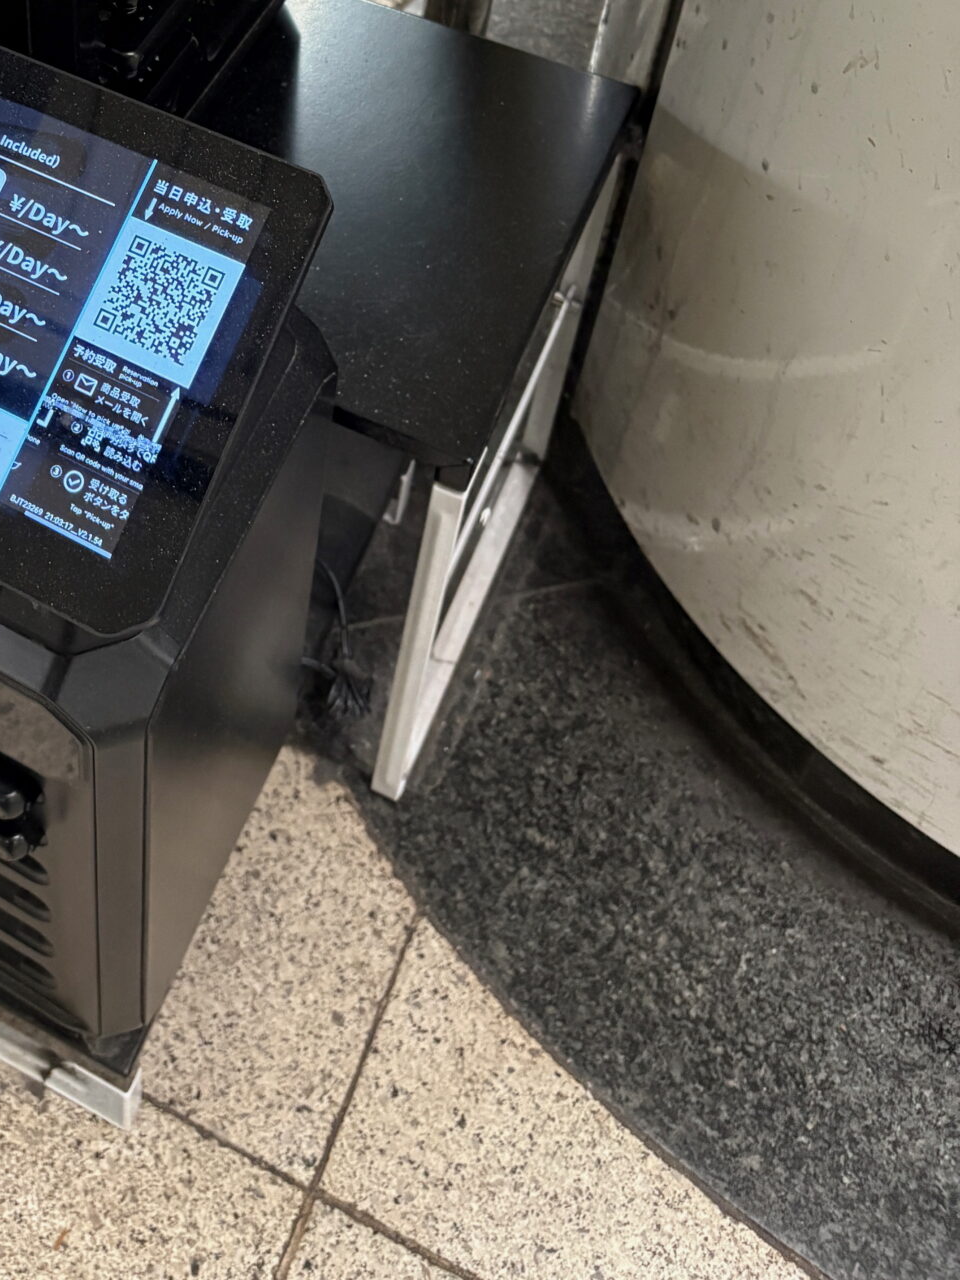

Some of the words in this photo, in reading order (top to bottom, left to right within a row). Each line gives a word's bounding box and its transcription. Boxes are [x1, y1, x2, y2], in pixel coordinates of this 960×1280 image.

[0, 134, 61, 169] Included)
[152, 178, 253, 231] 当日申込・受取
[157, 202, 184, 219] Apply
[183, 212, 204, 227] Now
[210, 223, 244, 245] Pick-up
[72, 343, 117, 374] 予約受取
[121, 364, 159, 387] Reservation
[99, 381, 141, 409] 商品受取
[94, 395, 149, 427] メールを開く
[87, 477, 128, 505] 受け取る
